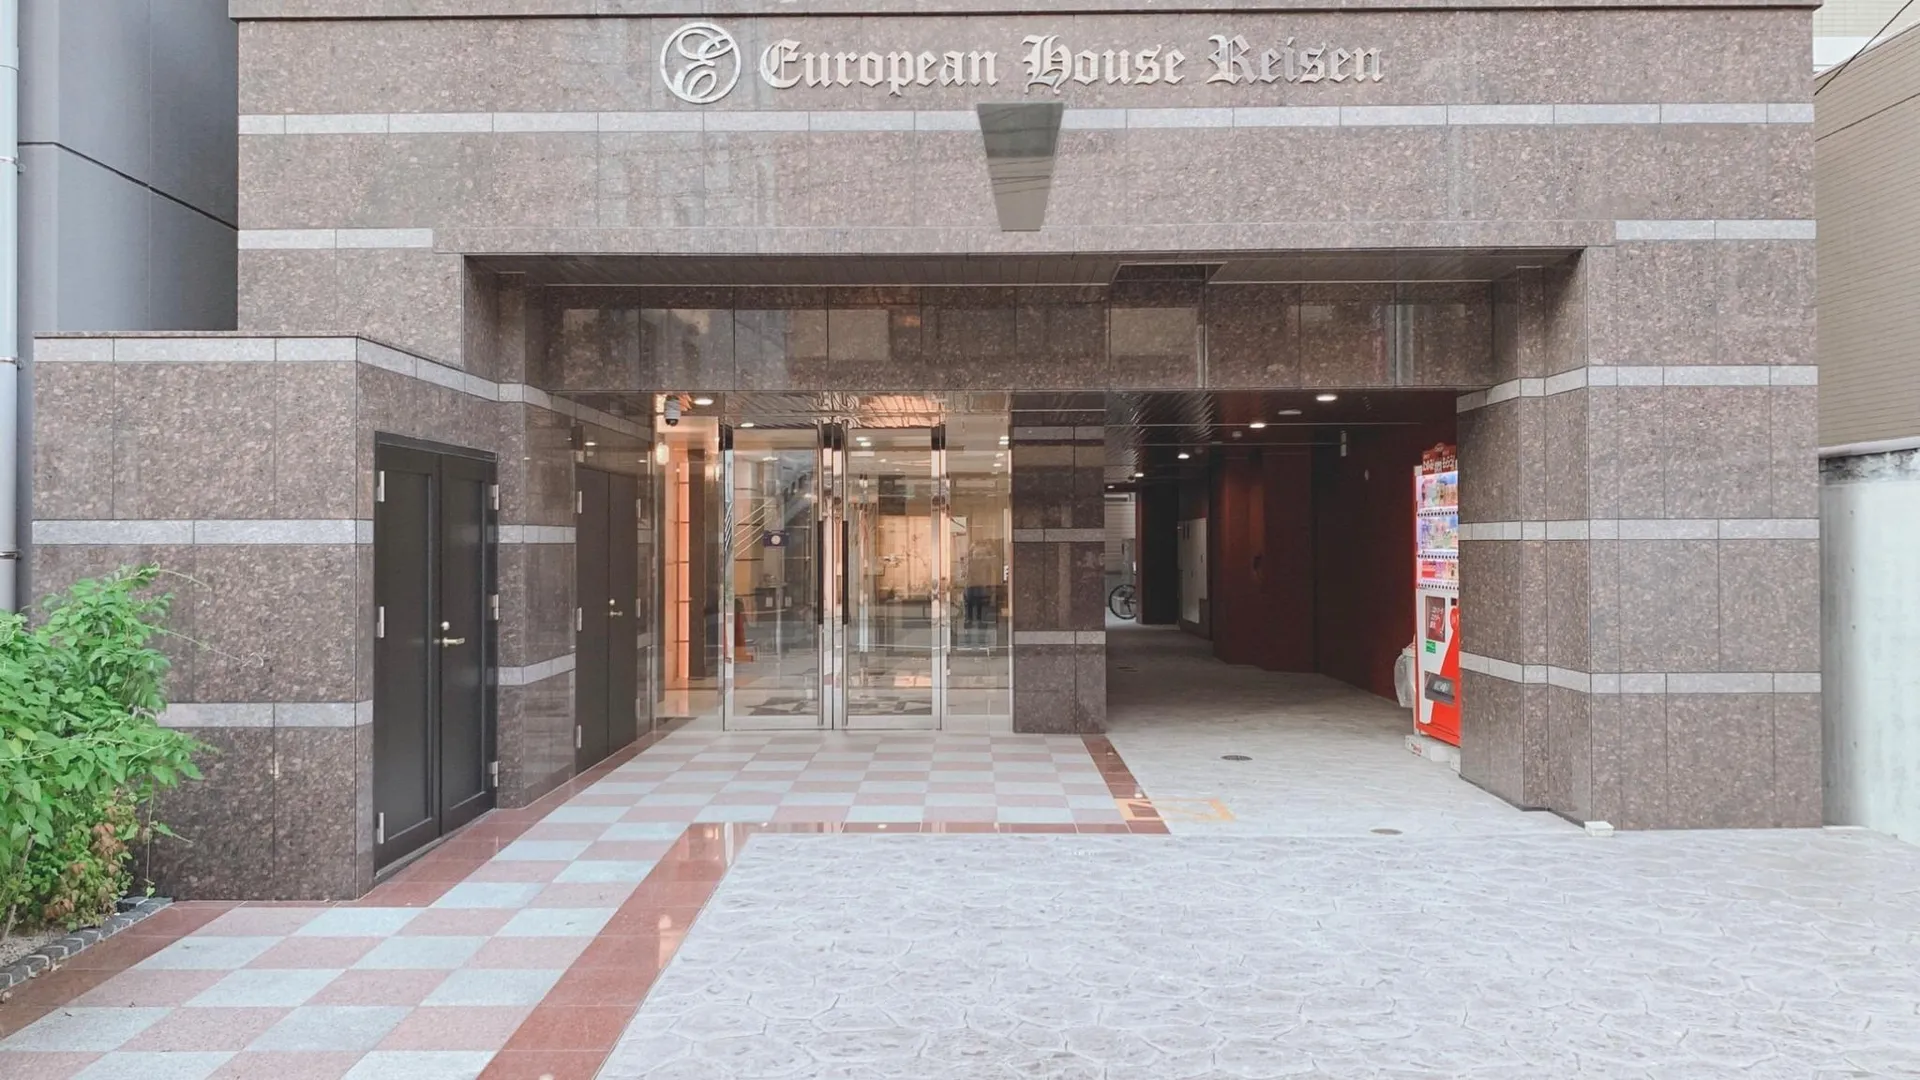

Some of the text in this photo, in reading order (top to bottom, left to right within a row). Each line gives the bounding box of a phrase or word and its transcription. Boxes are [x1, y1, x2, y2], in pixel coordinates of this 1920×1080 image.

[759, 34, 1385, 98] European House Reisen
